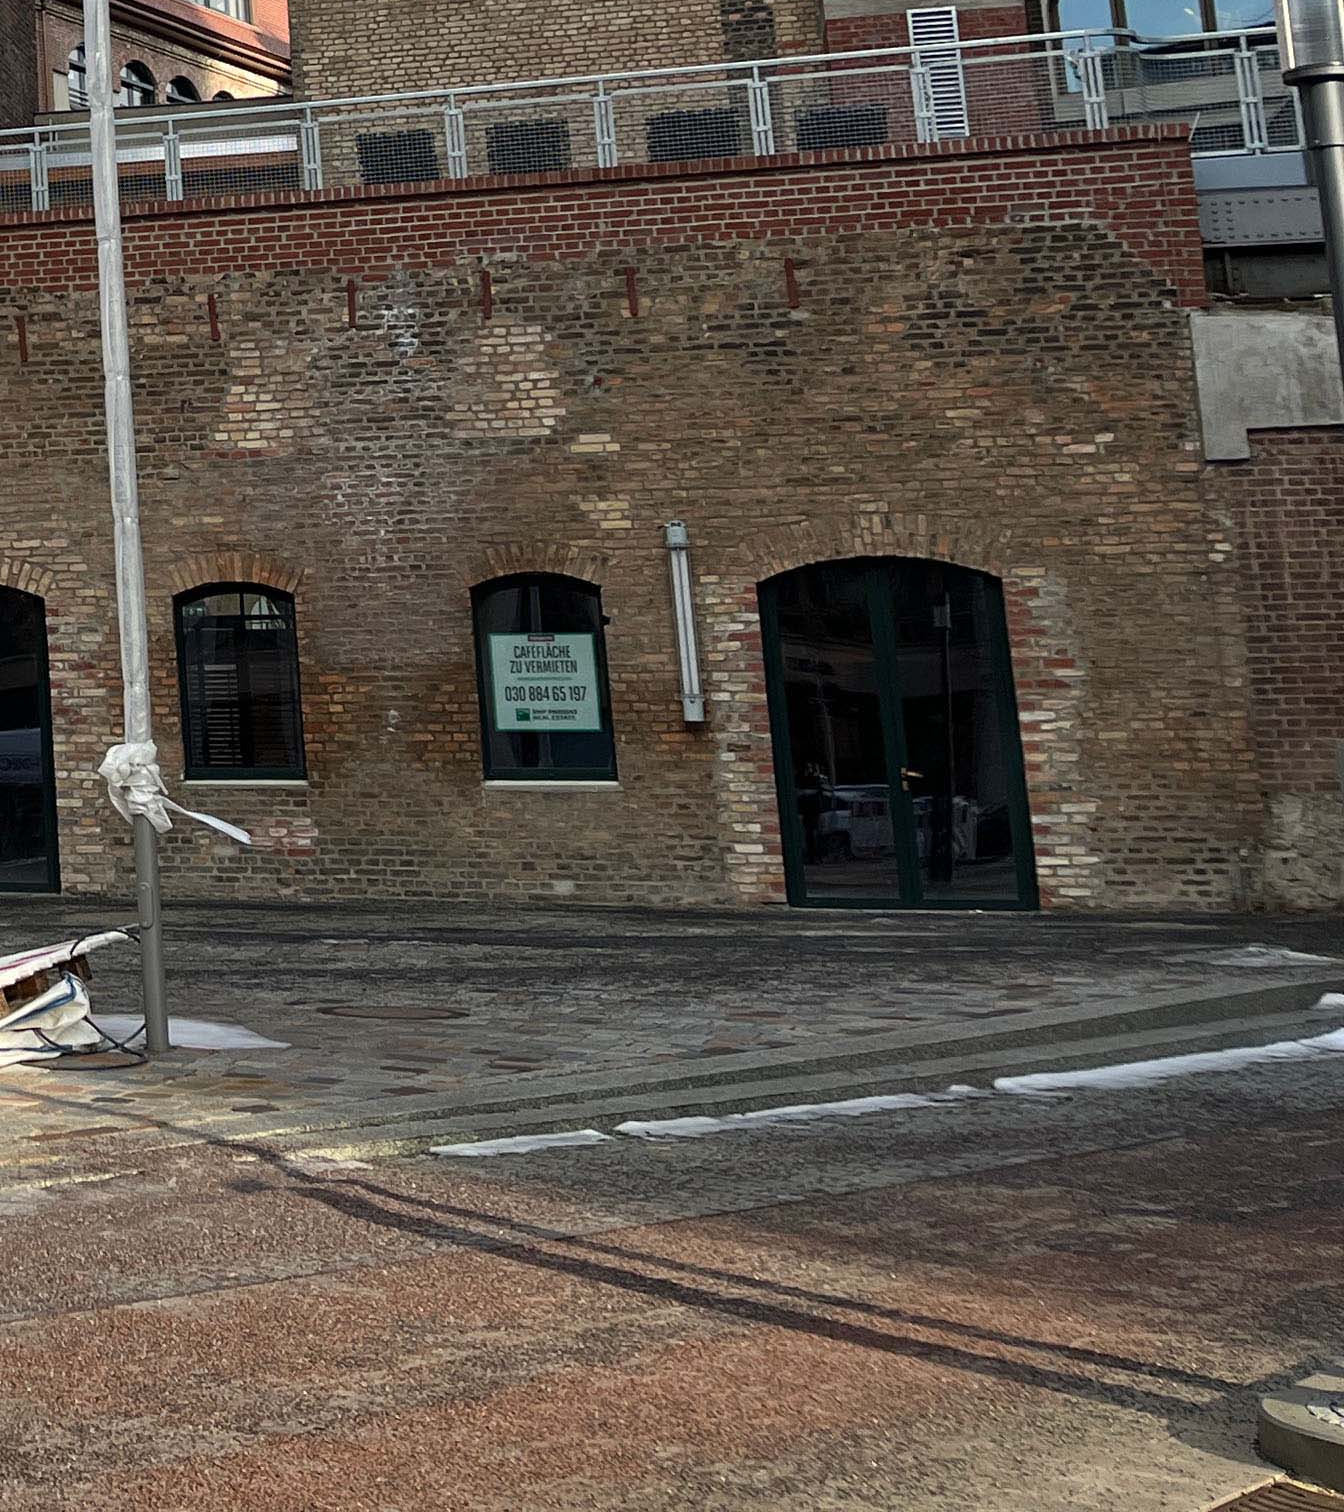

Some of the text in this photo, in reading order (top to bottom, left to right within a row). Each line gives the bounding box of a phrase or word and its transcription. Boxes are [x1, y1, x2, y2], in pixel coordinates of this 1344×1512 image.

[509, 660, 578, 674] ZU VERMIETEN
[505, 686, 587, 702] 030 884 65 197
